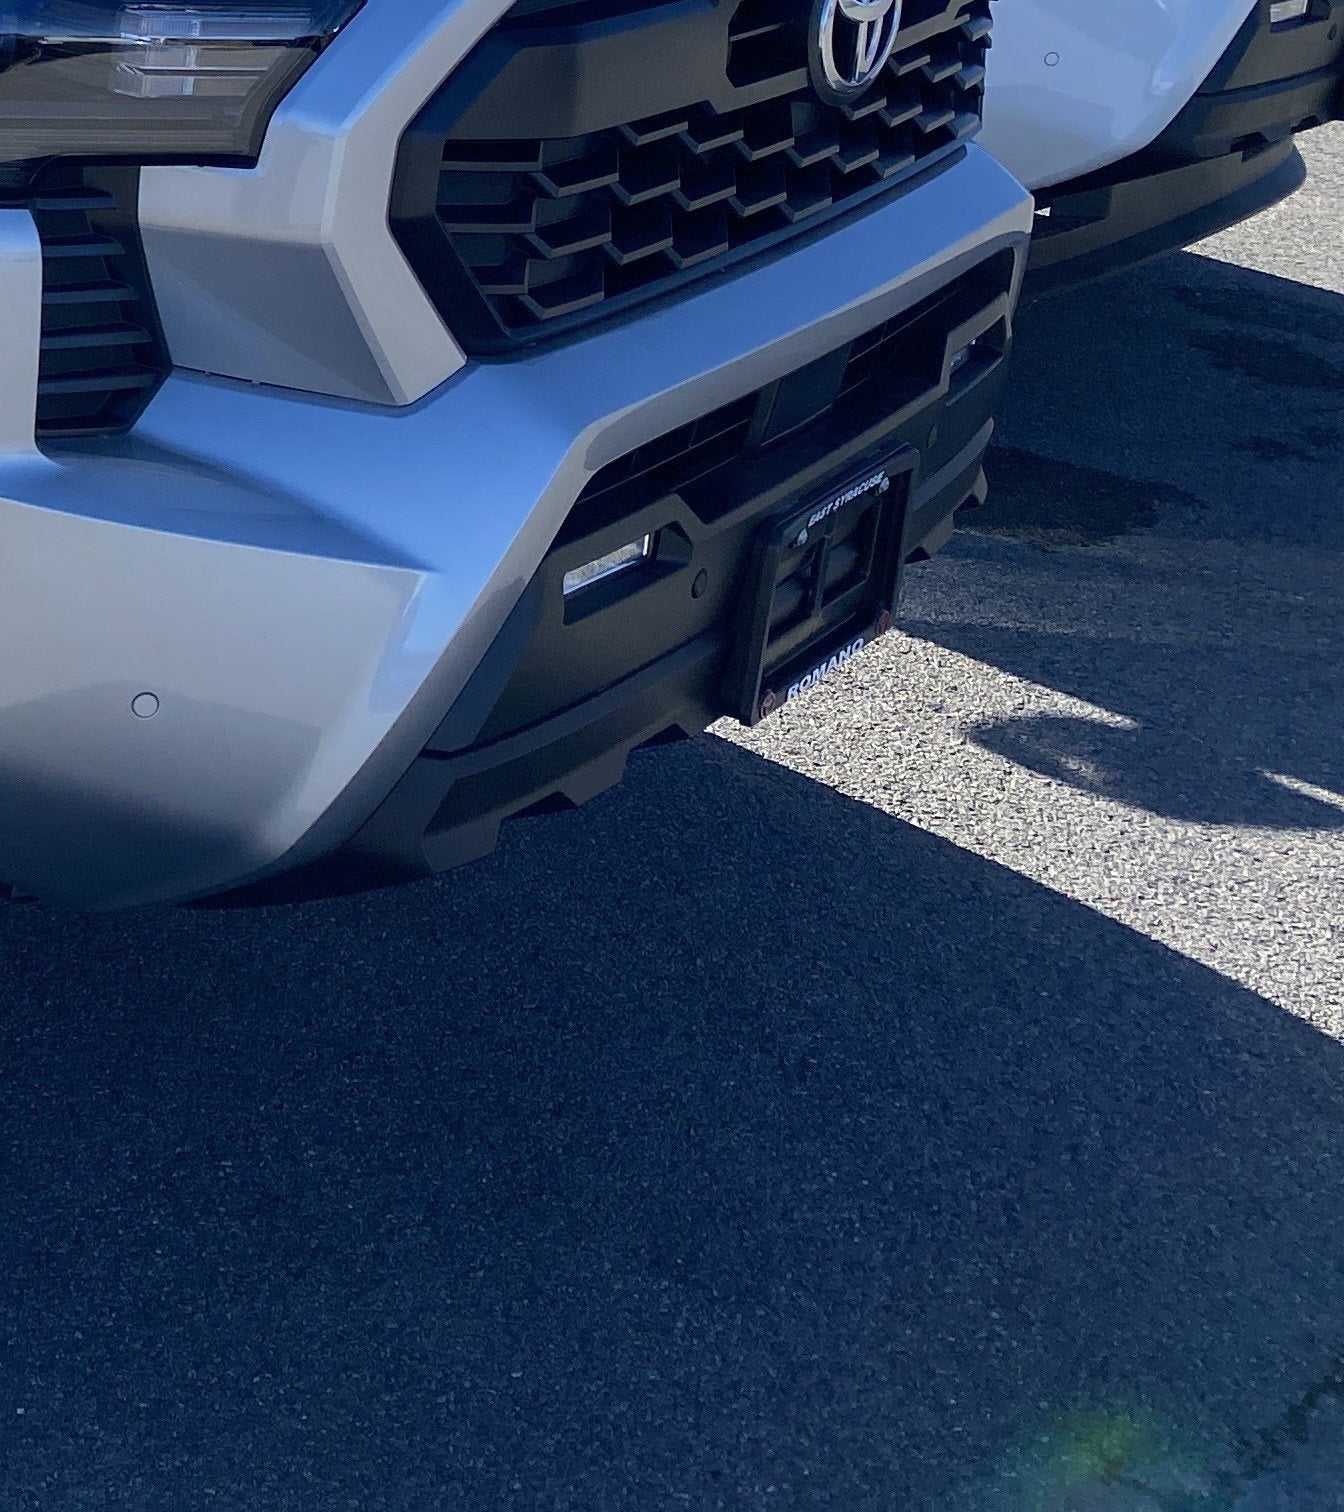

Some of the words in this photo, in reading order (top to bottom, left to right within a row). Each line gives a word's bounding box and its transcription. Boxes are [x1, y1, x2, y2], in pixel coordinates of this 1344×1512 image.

[808, 502, 833, 527] EAST
[832, 470, 885, 511] SYRACUSE
[787, 638, 864, 700] ROMANO
